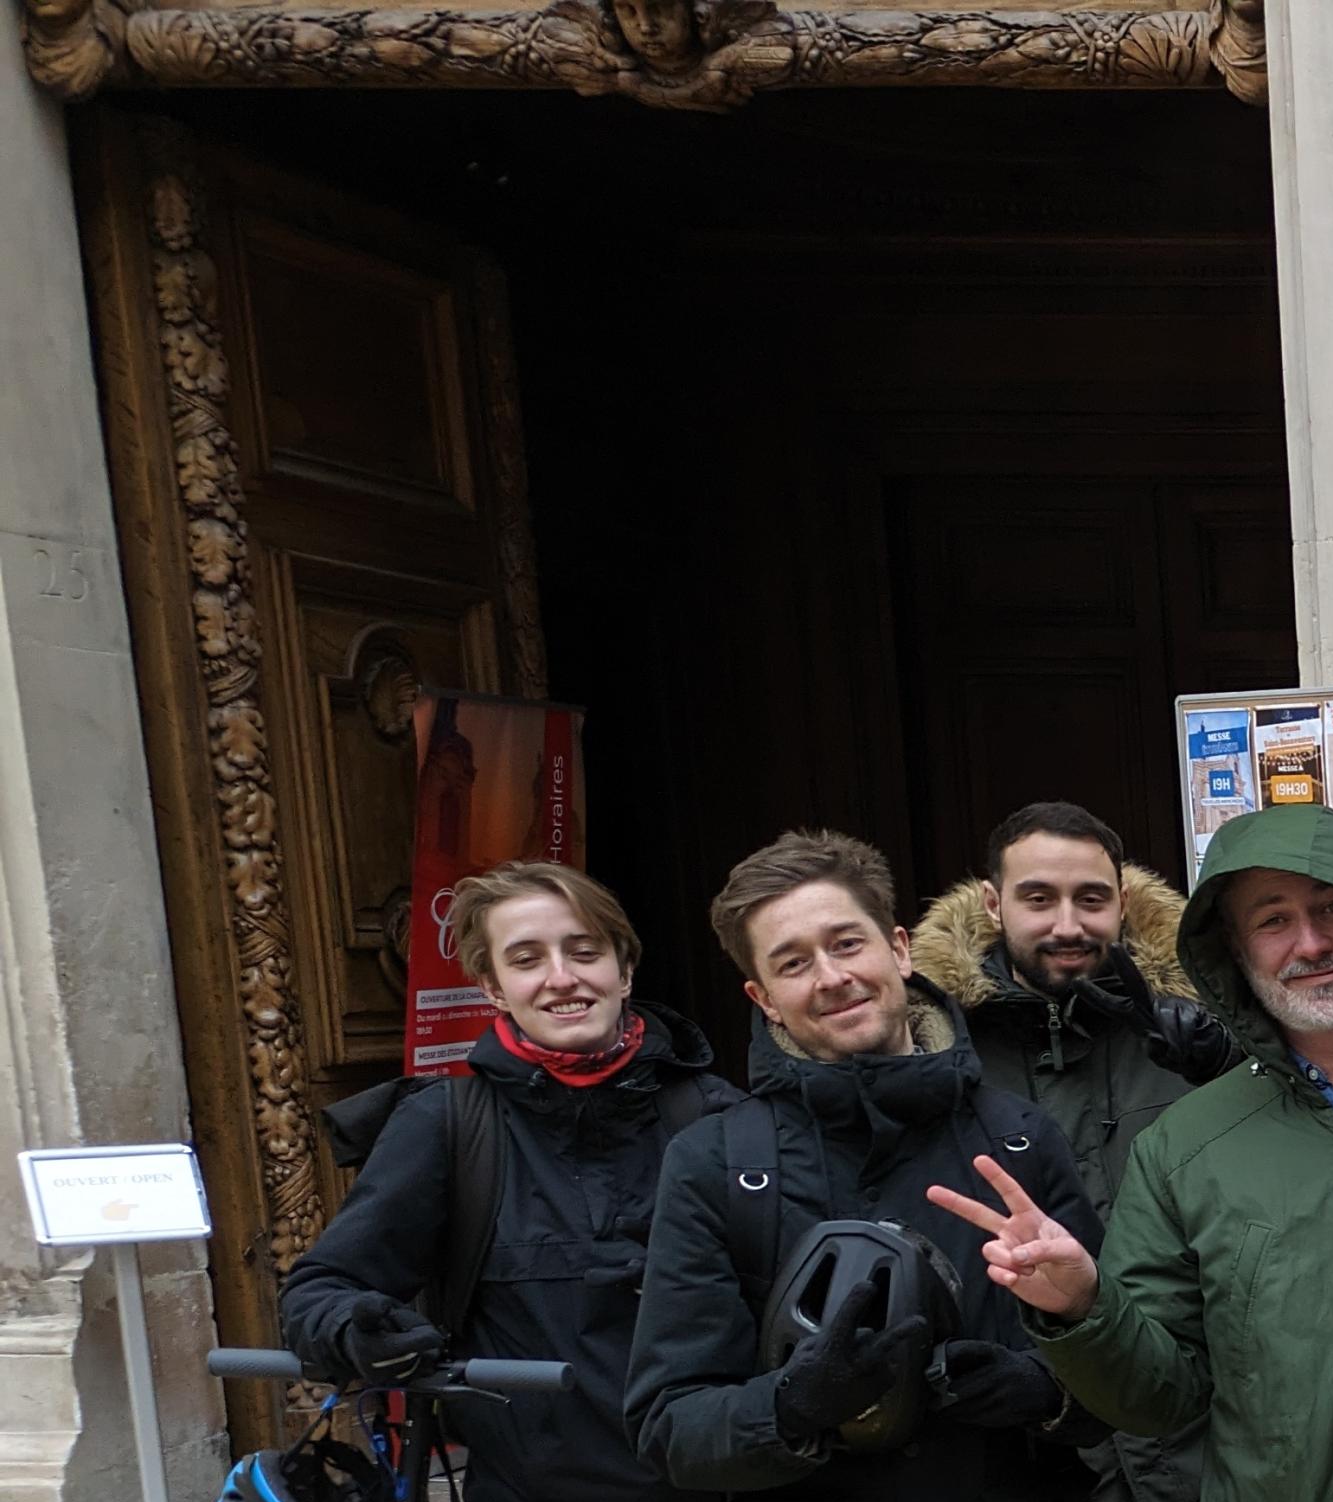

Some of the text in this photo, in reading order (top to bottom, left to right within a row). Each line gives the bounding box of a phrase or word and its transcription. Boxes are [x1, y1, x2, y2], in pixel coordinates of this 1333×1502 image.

[1212, 777, 1231, 791] 19H
[1275, 782, 1308, 796] 19H30
[549, 755, 564, 864] Horaires
[52, 1175, 119, 1188] OUVERT
[131, 1173, 174, 1184] OPEN
